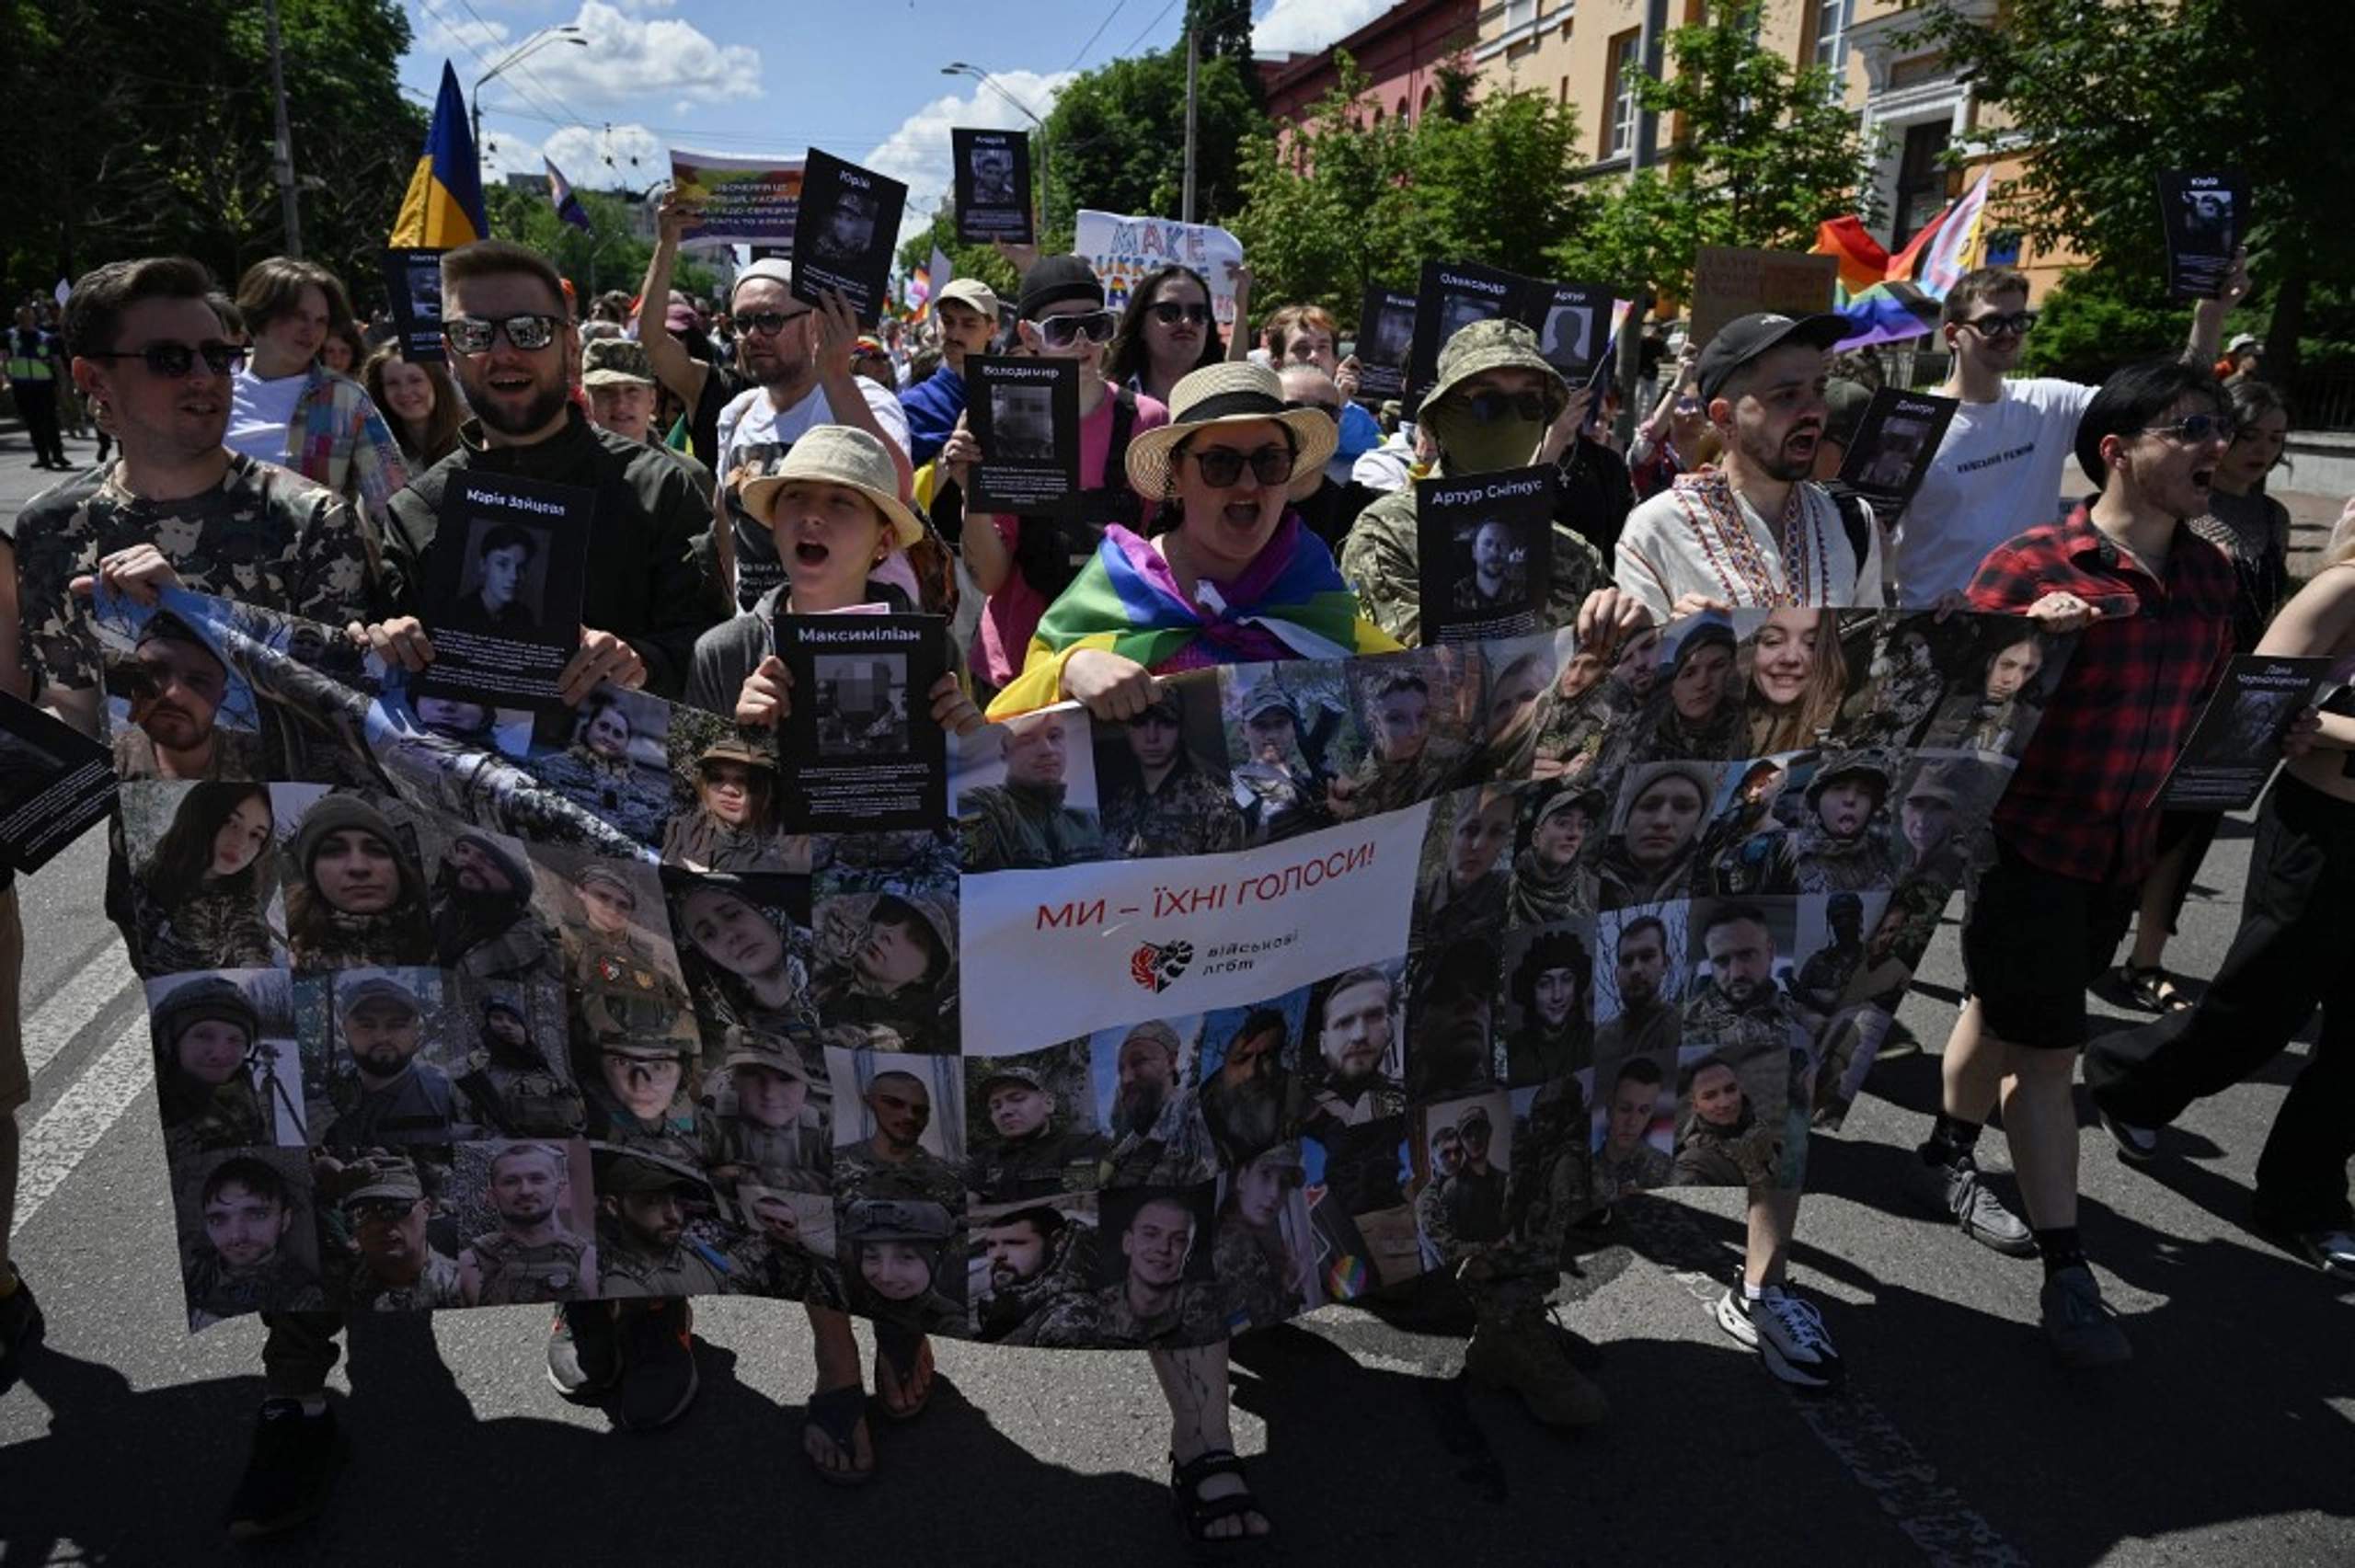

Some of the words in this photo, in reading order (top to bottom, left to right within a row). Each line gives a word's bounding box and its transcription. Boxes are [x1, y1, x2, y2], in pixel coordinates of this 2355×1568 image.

[838, 170, 870, 189] Юрій
[1109, 222, 1207, 264] MAKE
[1096, 255, 1210, 281] UKRAE
[1441, 273, 1507, 295] Олександр
[1554, 290, 1586, 301] Артур
[982, 366, 1060, 378] Володимир
[466, 488, 505, 505] Марія
[508, 495, 565, 516] Зайцева
[1432, 489, 1483, 506] Артур
[1488, 480, 1543, 498] Сніткус
[798, 627, 921, 642] Максиміліан
[1036, 898, 1107, 930] МИ
[1154, 884, 1227, 919] ЇХНІ
[1237, 841, 1375, 906] ГОЛОСИ!
[1207, 930, 1299, 957] військові
[1202, 959, 1254, 976] лгбт
